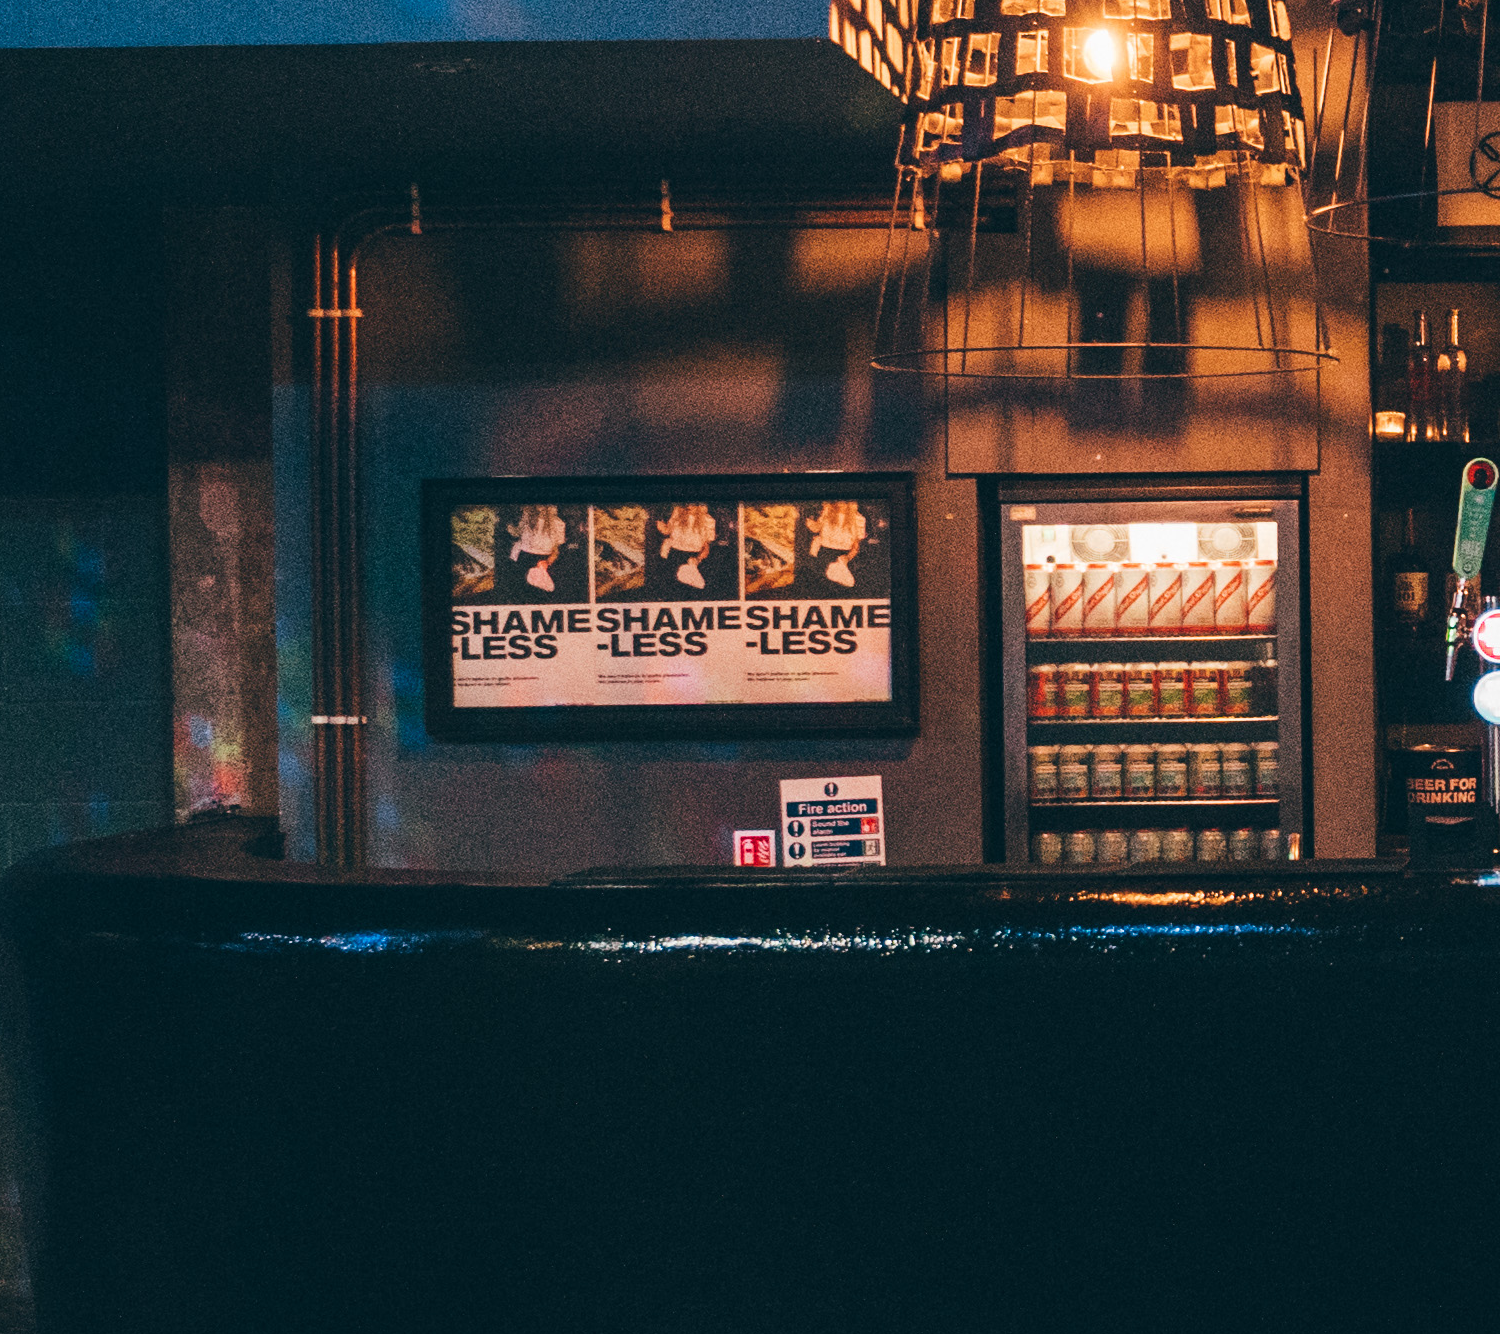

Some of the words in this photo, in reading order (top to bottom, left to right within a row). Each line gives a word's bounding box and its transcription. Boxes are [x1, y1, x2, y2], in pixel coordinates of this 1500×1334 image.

[452, 609, 592, 635] SHAME
[596, 606, 742, 632] SHAME
[745, 605, 890, 630] SHAME
[597, 631, 708, 657] -LESS
[746, 630, 858, 655] -LESS
[1407, 790, 1476, 803] DRINKING
[1449, 777, 1477, 791] FOR
[798, 803, 824, 815] Fire
[827, 801, 867, 813] action
